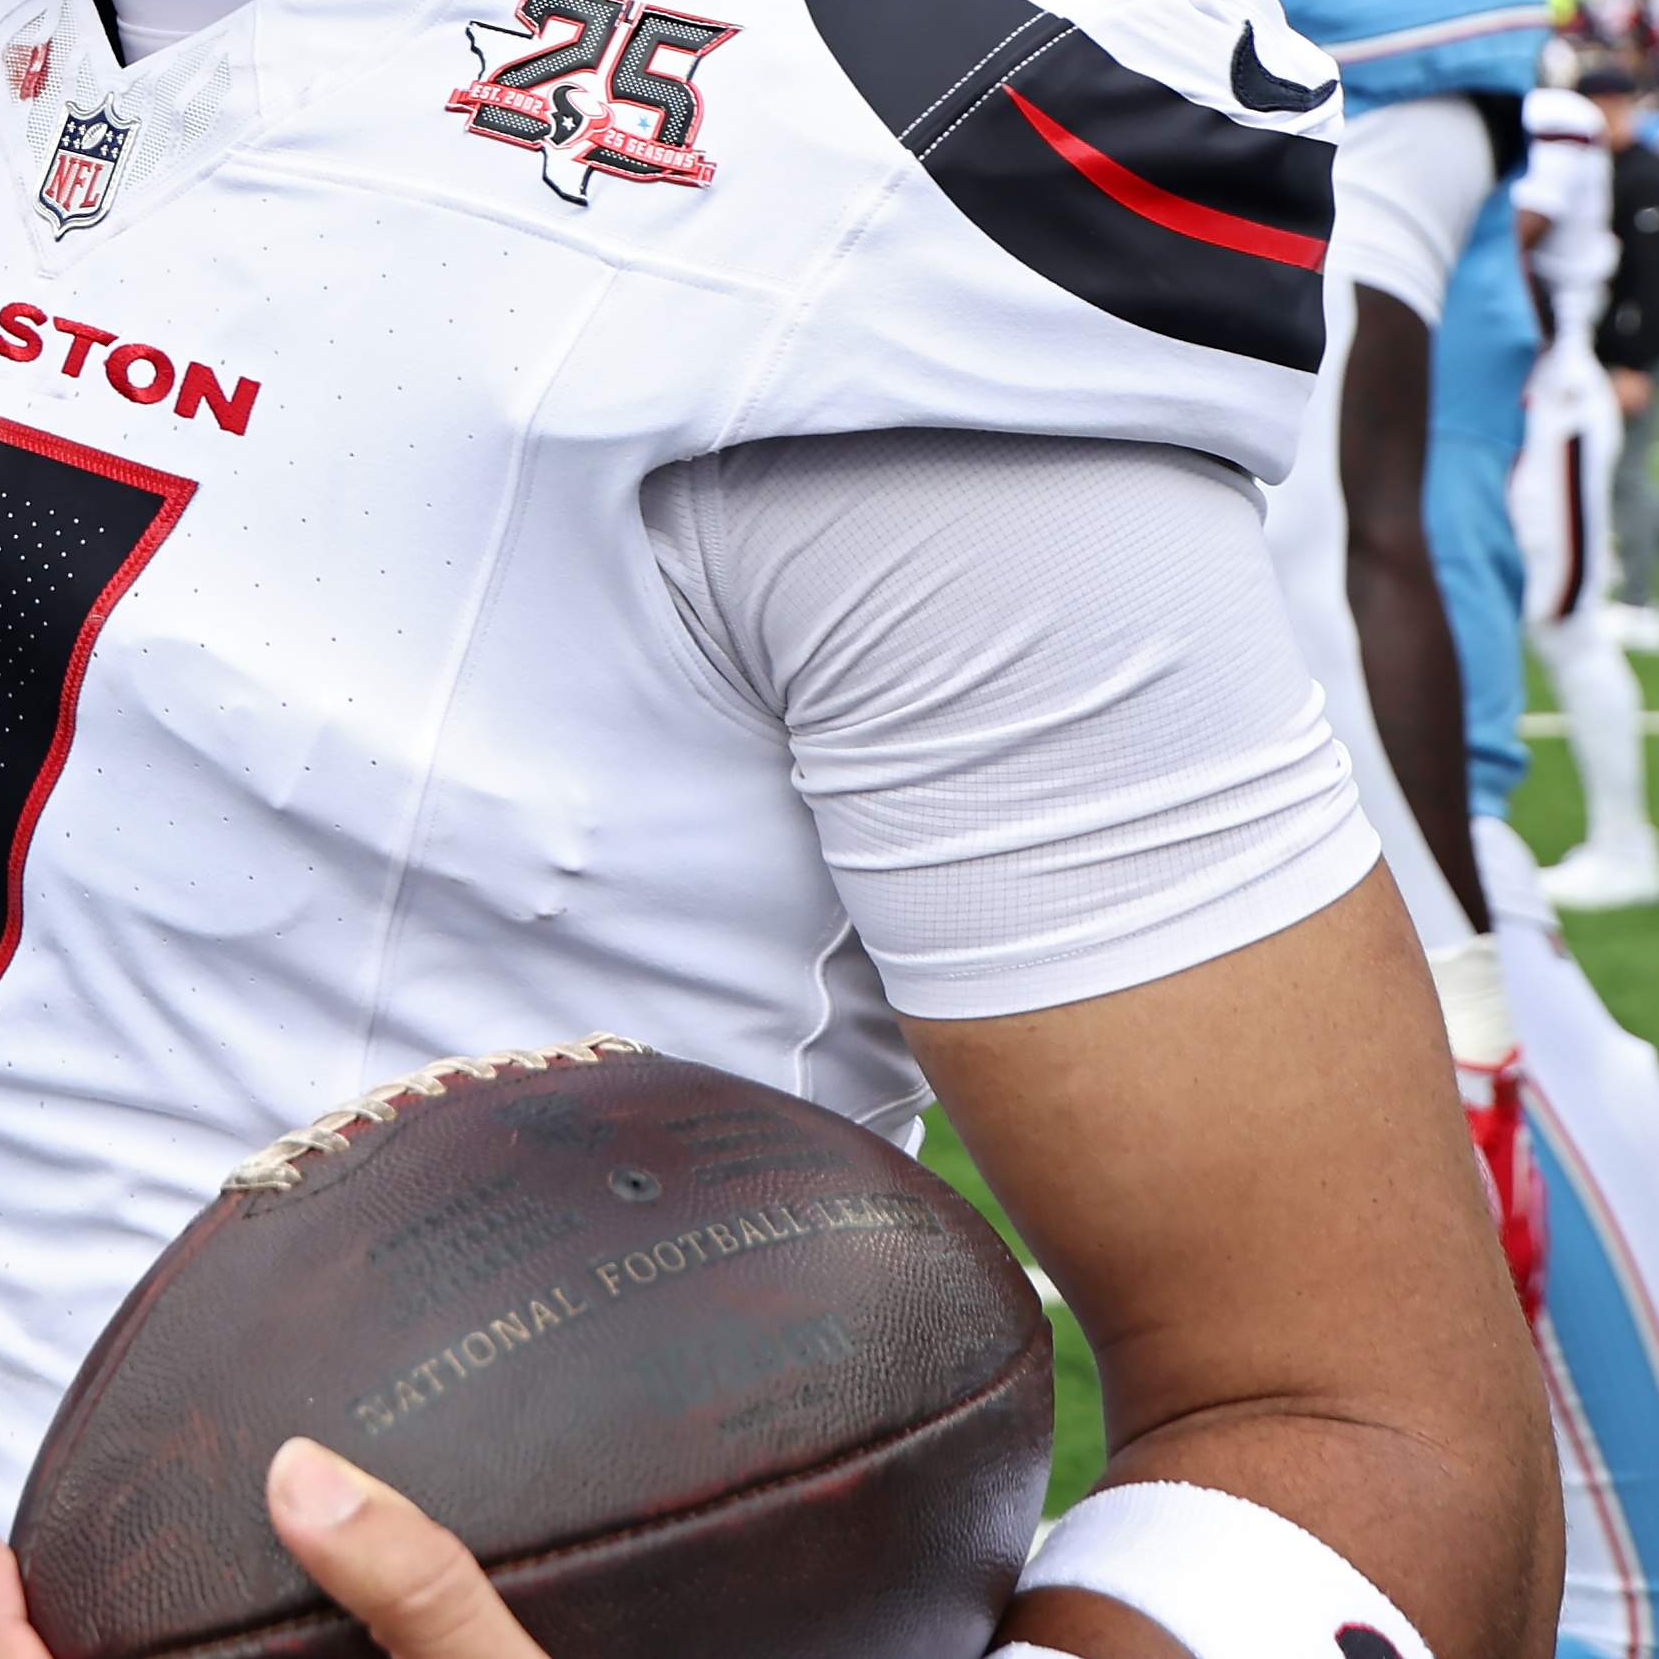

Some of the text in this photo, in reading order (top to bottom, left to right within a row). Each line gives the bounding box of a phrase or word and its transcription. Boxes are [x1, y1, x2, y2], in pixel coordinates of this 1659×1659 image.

[471, 83, 545, 116] EST. 2002
[603, 128, 696, 169] 25 SEASONS
[44, 153, 105, 212] NFL
[356, 1286, 588, 1436] NATIONAL
[594, 1201, 811, 1297] FOOTBALL
[811, 1193, 943, 1236] LEA
